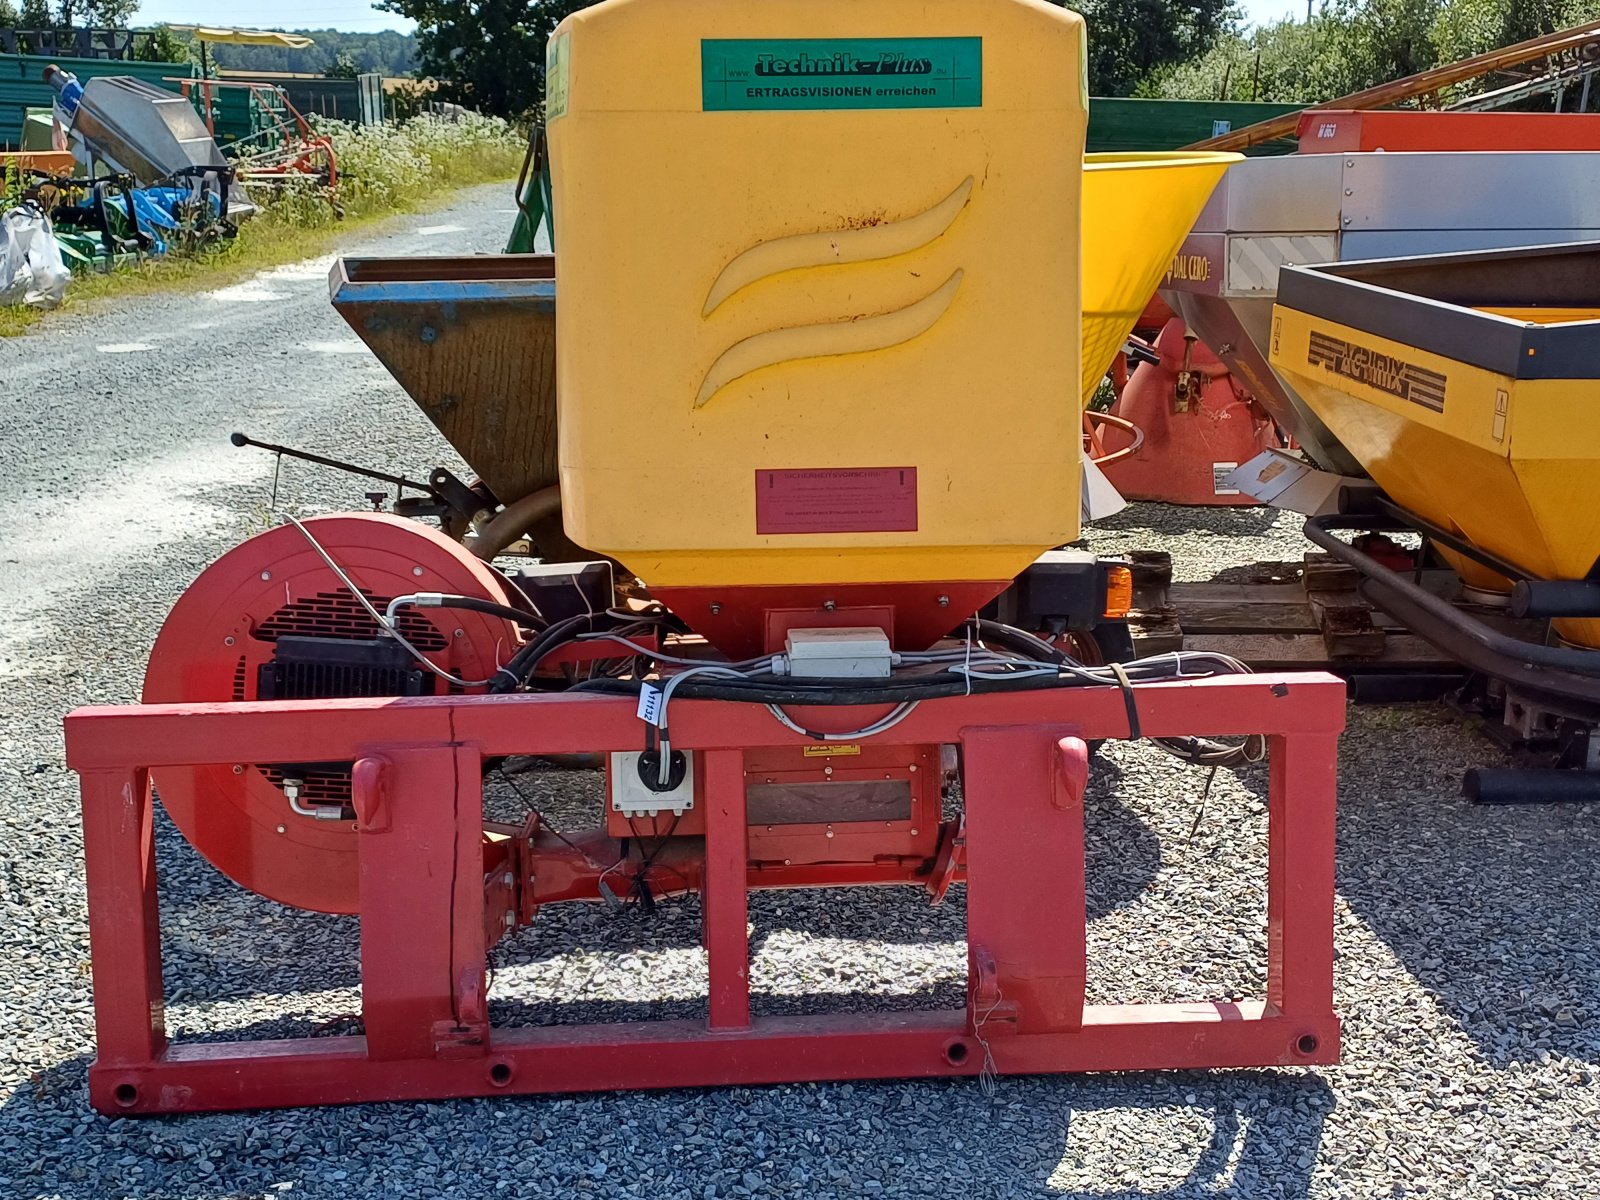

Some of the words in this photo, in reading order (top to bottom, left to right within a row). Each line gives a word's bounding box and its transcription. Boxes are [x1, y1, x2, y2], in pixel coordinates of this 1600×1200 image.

[746, 86, 872, 97] ERTRAGSVISIONEN
[876, 86, 936, 96] erreichen
[1173, 255, 1187, 279] DAL
